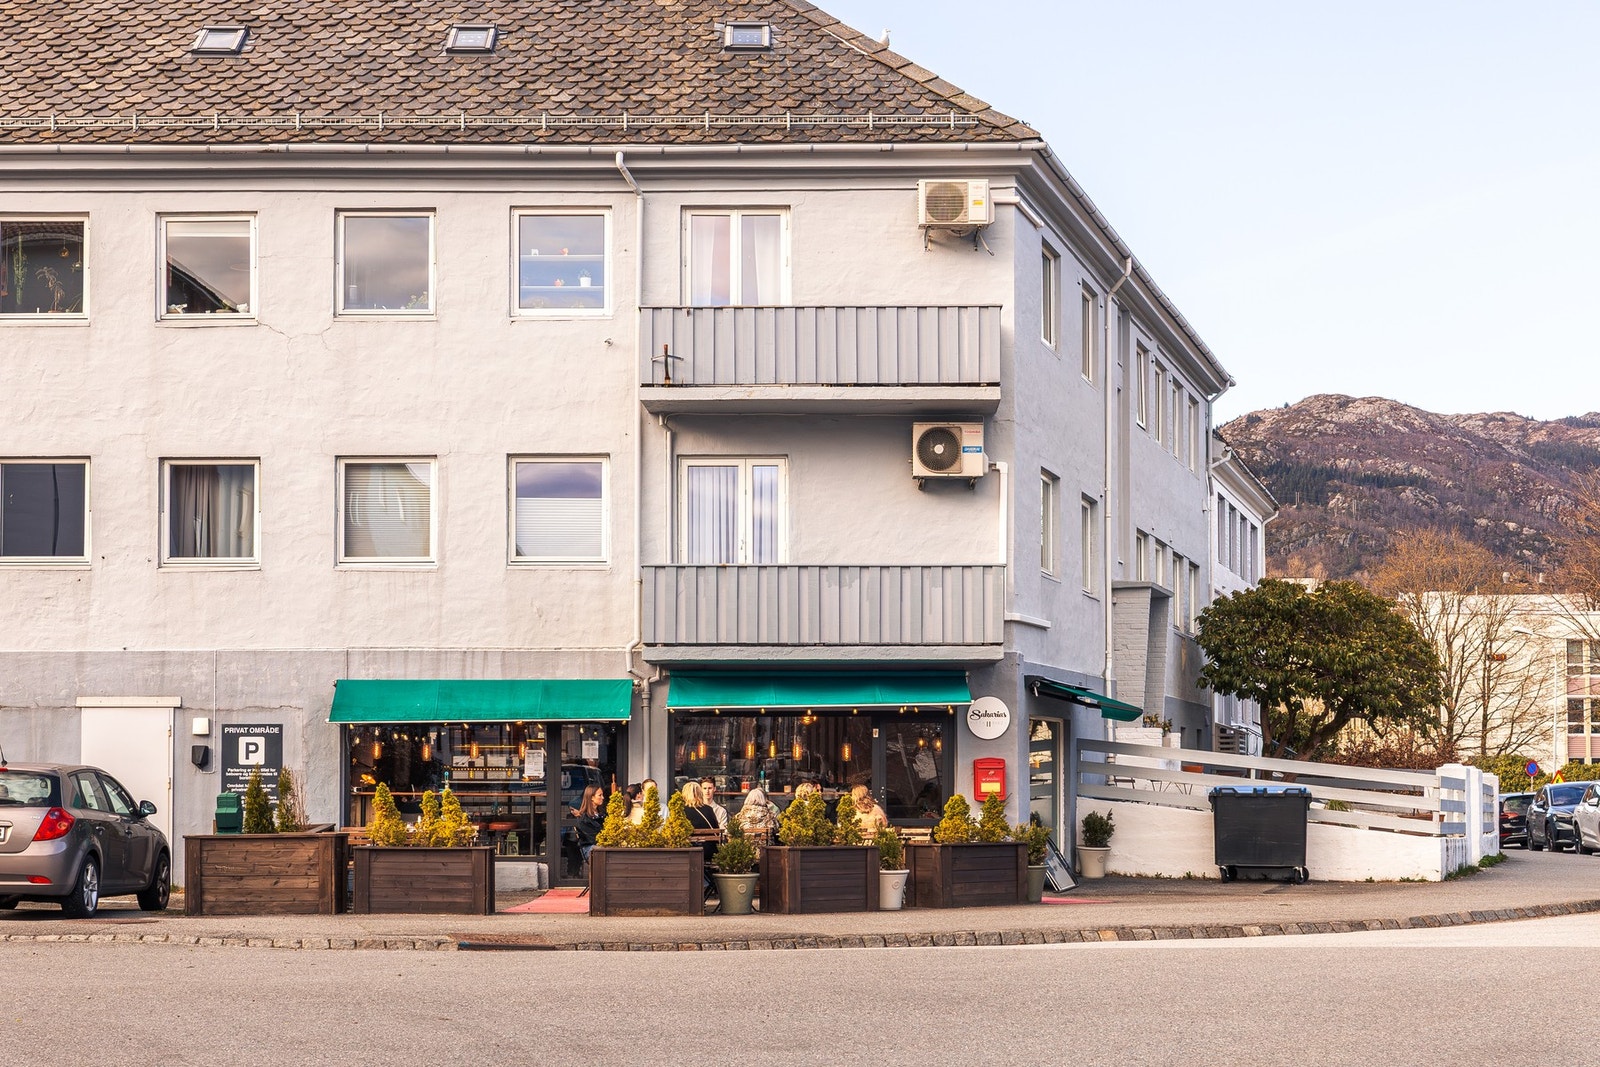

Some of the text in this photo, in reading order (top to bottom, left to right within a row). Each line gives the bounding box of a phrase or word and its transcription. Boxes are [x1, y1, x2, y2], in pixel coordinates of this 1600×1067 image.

[970, 709, 1007, 721] Sakarias
[249, 726, 280, 734] OMRÅDE
[245, 742, 259, 760] P
